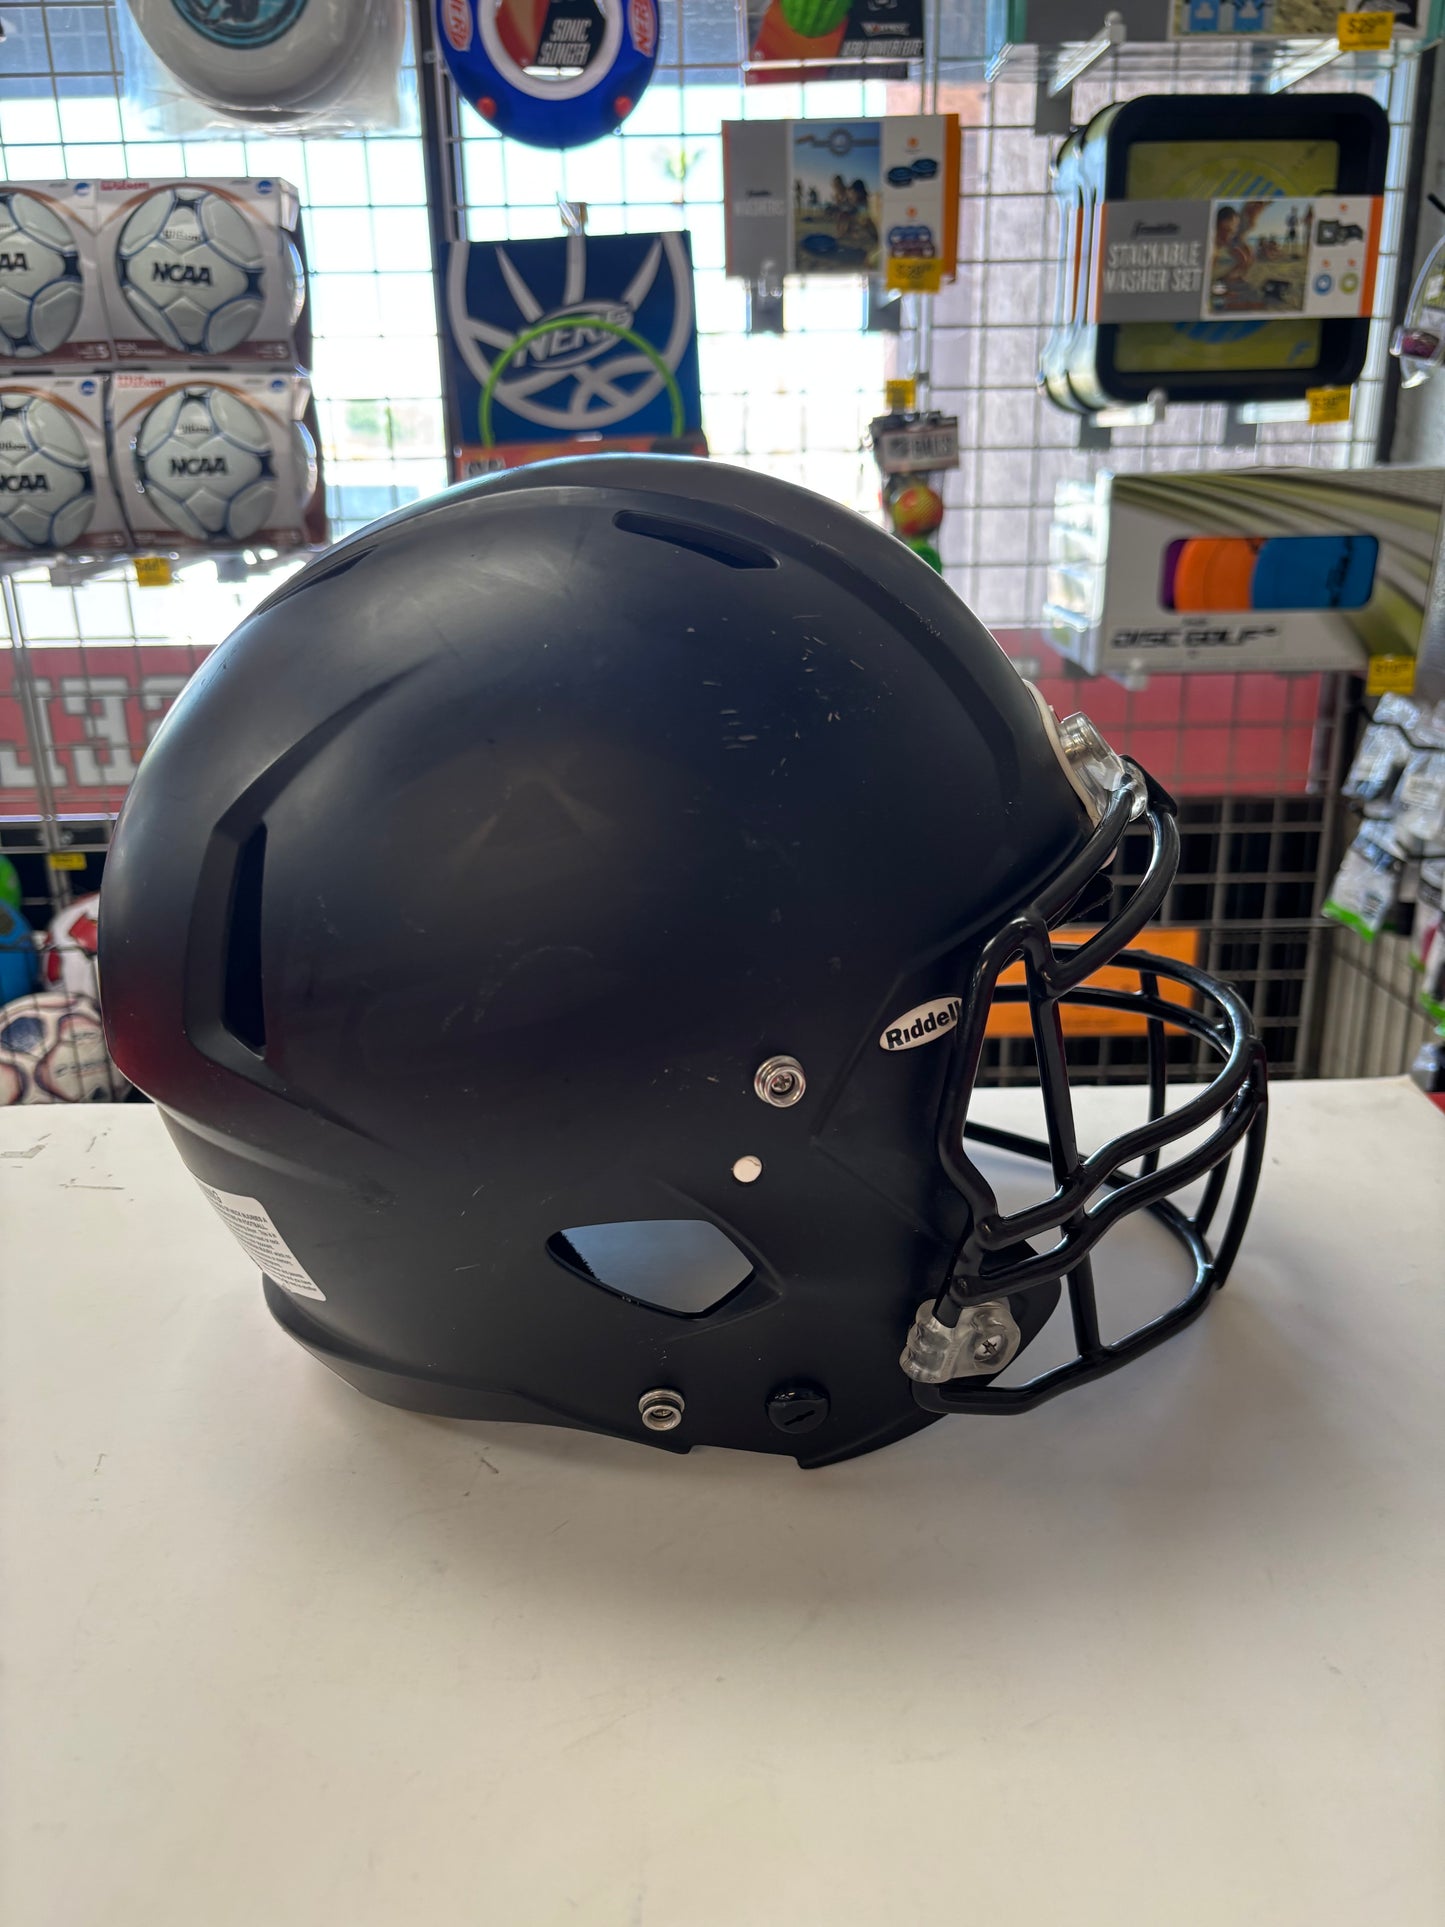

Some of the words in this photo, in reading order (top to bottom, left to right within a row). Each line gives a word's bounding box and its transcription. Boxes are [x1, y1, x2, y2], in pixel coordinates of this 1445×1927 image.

[550, 18, 592, 41] SONIC
[537, 41, 591, 65] SLINGER
[1107, 241, 1201, 268] STACKABLE
[152, 262, 213, 286] NCAA
[1103, 268, 1169, 293] WASHER
[1170, 267, 1202, 293] SET
[170, 458, 228, 477] NCAA
[1110, 627, 1179, 649] DISC
[1183, 625, 1256, 648] GOLF
